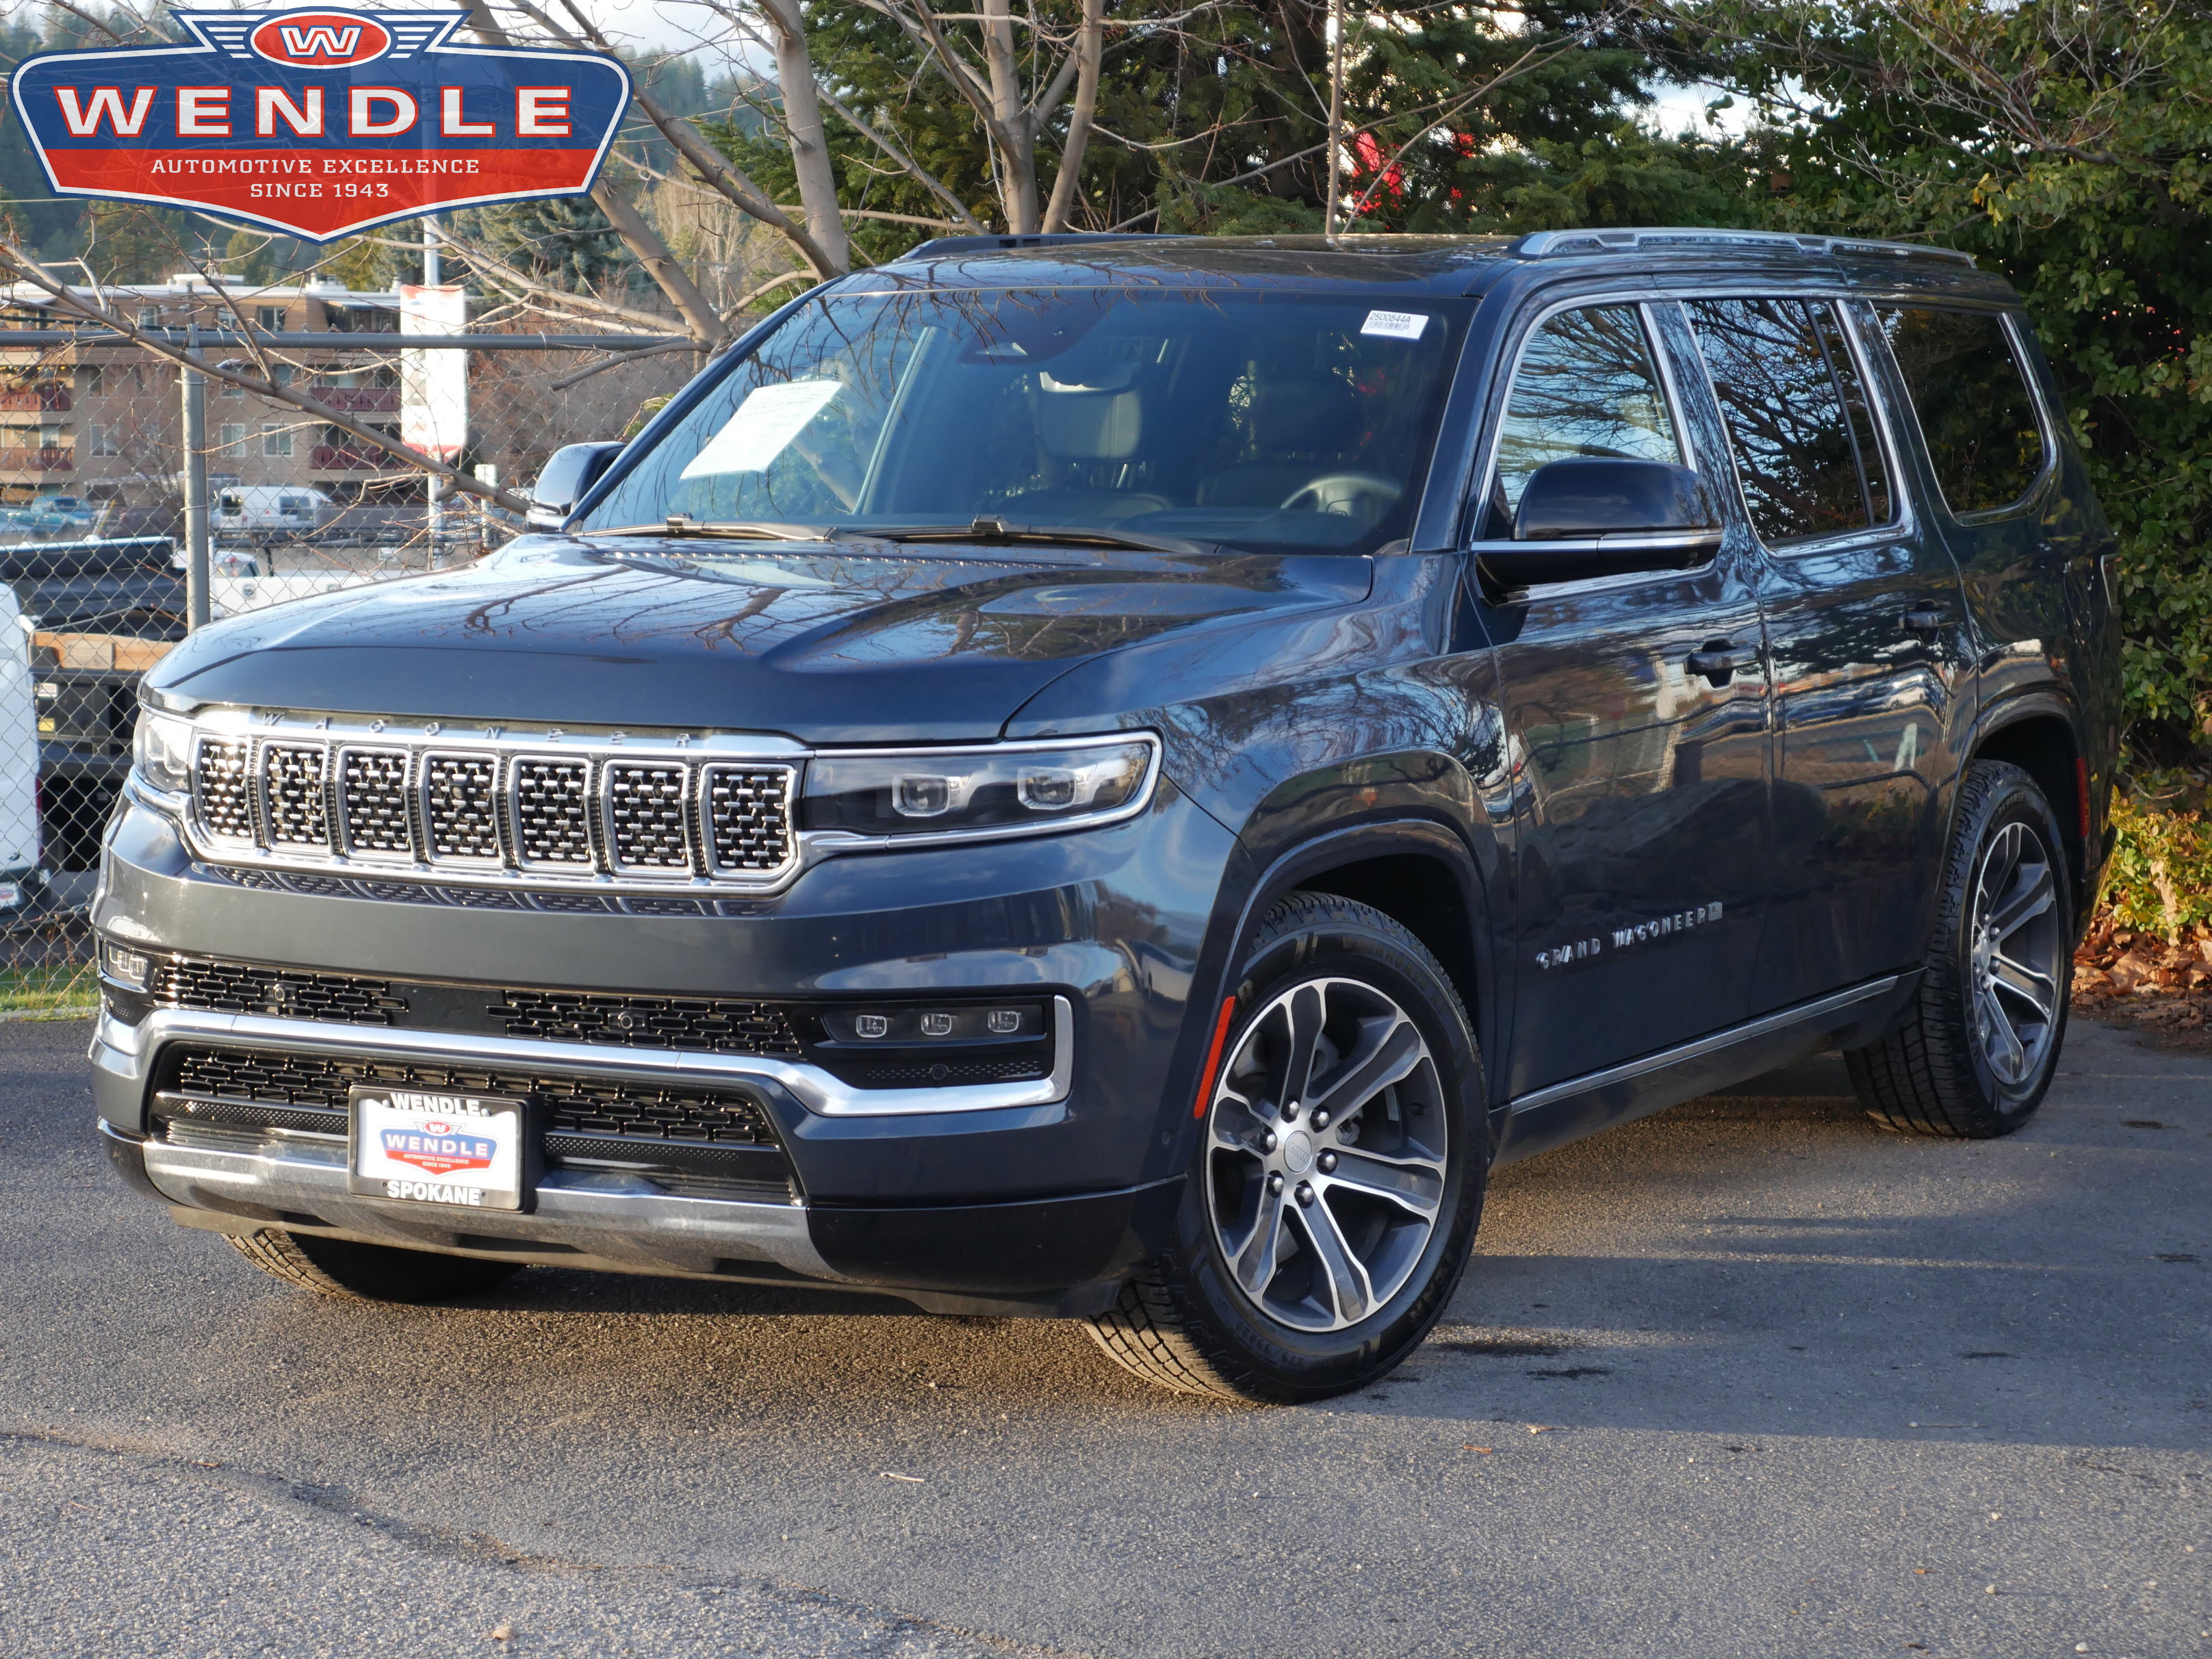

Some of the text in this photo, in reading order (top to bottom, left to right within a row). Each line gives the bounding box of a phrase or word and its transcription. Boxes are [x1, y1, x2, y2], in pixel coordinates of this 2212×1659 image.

[1369, 312, 1411, 324] 2500844A
[263, 711, 691, 748] WAGONEER
[1535, 907, 1706, 970] GRAND WAGONEER
[389, 1092, 480, 1117] WENDLE
[385, 1133, 488, 1157] WENDLE
[403, 1153, 469, 1164] AUTOMOTIVE EXCELLENCE
[387, 1179, 480, 1207] SPOKANE
